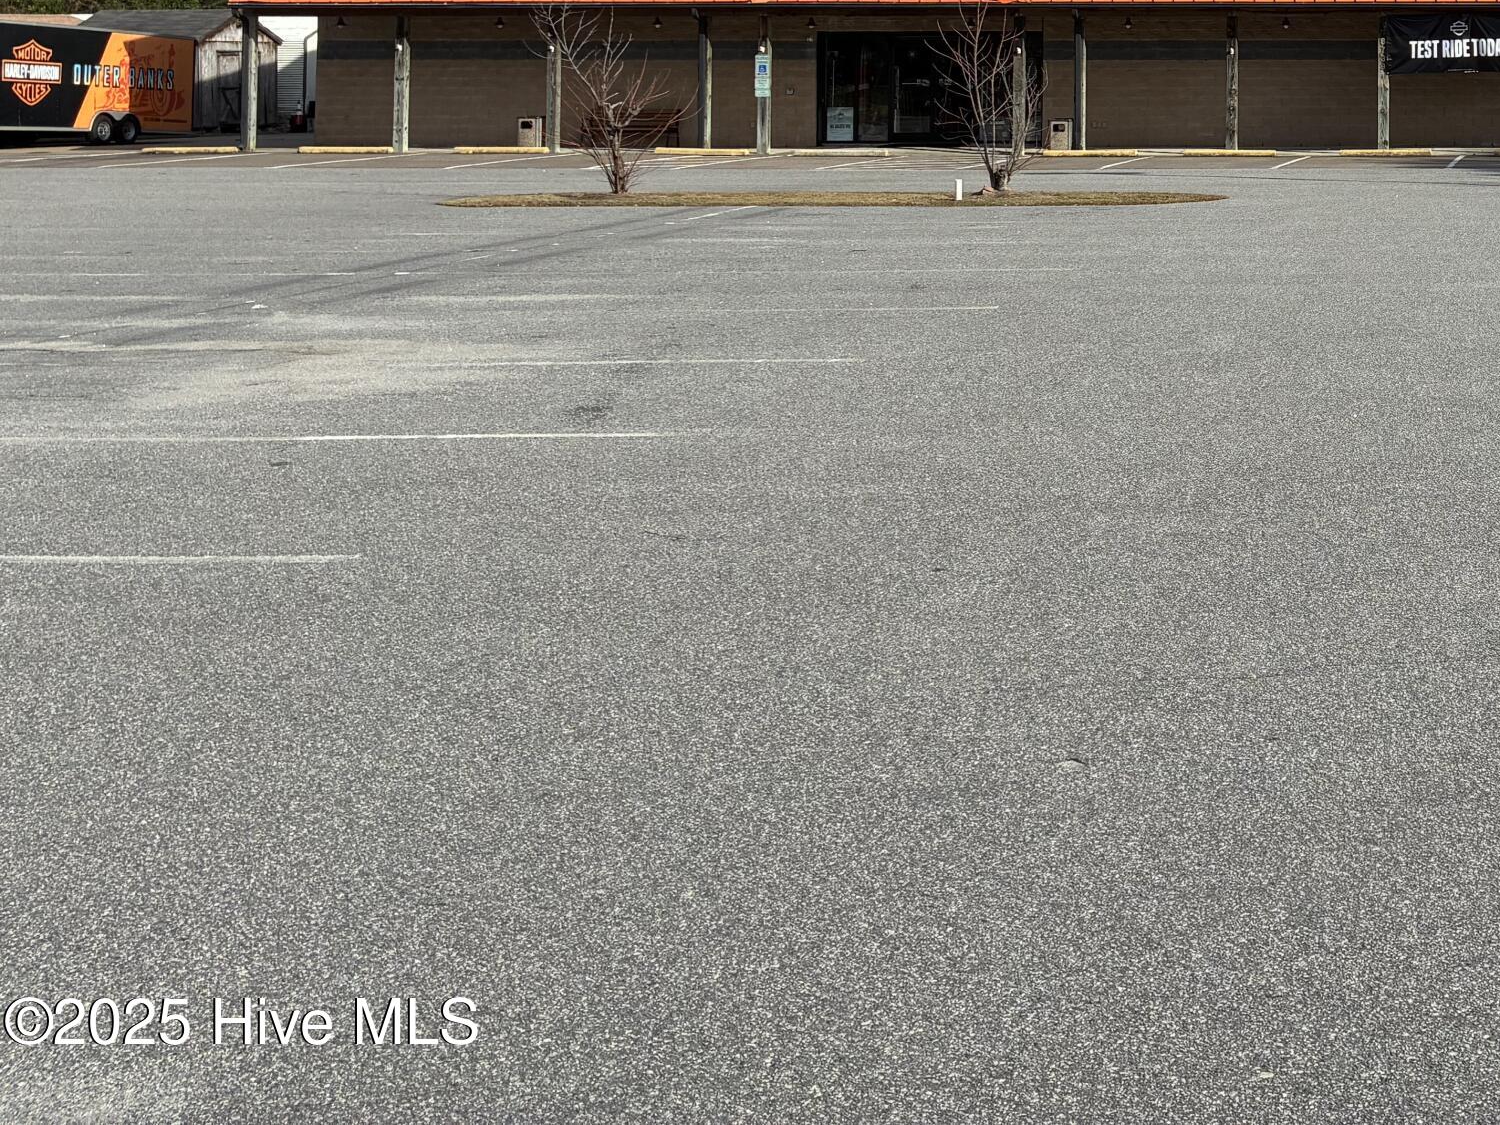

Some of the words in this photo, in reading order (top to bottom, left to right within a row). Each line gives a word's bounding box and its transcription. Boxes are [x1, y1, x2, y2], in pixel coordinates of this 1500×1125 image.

[17, 44, 48, 60] MOTOR
[1409, 39, 1440, 59] TEST
[1441, 38, 1471, 58] RIDE
[4, 63, 60, 81] HARLEY-DAVIDSON
[73, 63, 121, 88] OUTER
[129, 67, 175, 91] BANKS
[16, 83, 47, 102] CYCLES
